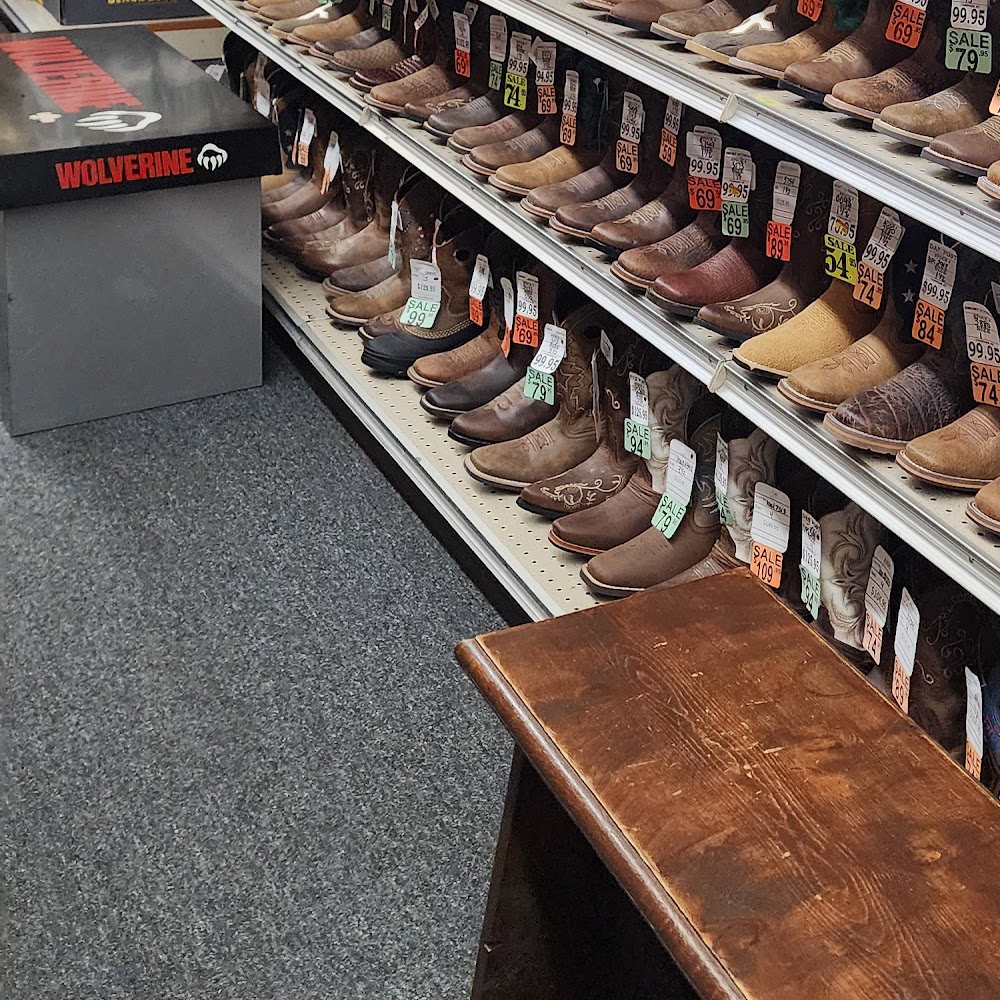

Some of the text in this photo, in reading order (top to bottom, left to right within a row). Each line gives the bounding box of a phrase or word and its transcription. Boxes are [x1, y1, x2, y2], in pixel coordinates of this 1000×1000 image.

[894, 5, 925, 26] SALE
[952, 6, 985, 26] 99.95
[948, 31, 989, 49] SALE
[509, 58, 527, 73] 99.95
[506, 76, 526, 86] SALE
[55, 148, 195, 191] WOLVERINE
[690, 159, 719, 176] 99.95
[688, 178, 721, 188] SALE
[723, 204, 748, 217] SALE
[768, 224, 791, 239] SALE
[827, 237, 855, 255] SALE
[863, 244, 890, 269] 99.95
[858, 265, 883, 285] SALE
[923, 279, 950, 304] $99.95
[407, 299, 438, 313] SALE
[517, 301, 537, 318] 99.95
[917, 302, 945, 327] SALE
[515, 317, 538, 332] SALE
[535, 353, 558, 370] 99.95
[968, 341, 1000, 364] 99.95
[528, 368, 553, 386] SALE
[626, 421, 650, 439] SALE
[661, 495, 685, 518] SALE
[753, 544, 783, 567] SALE
